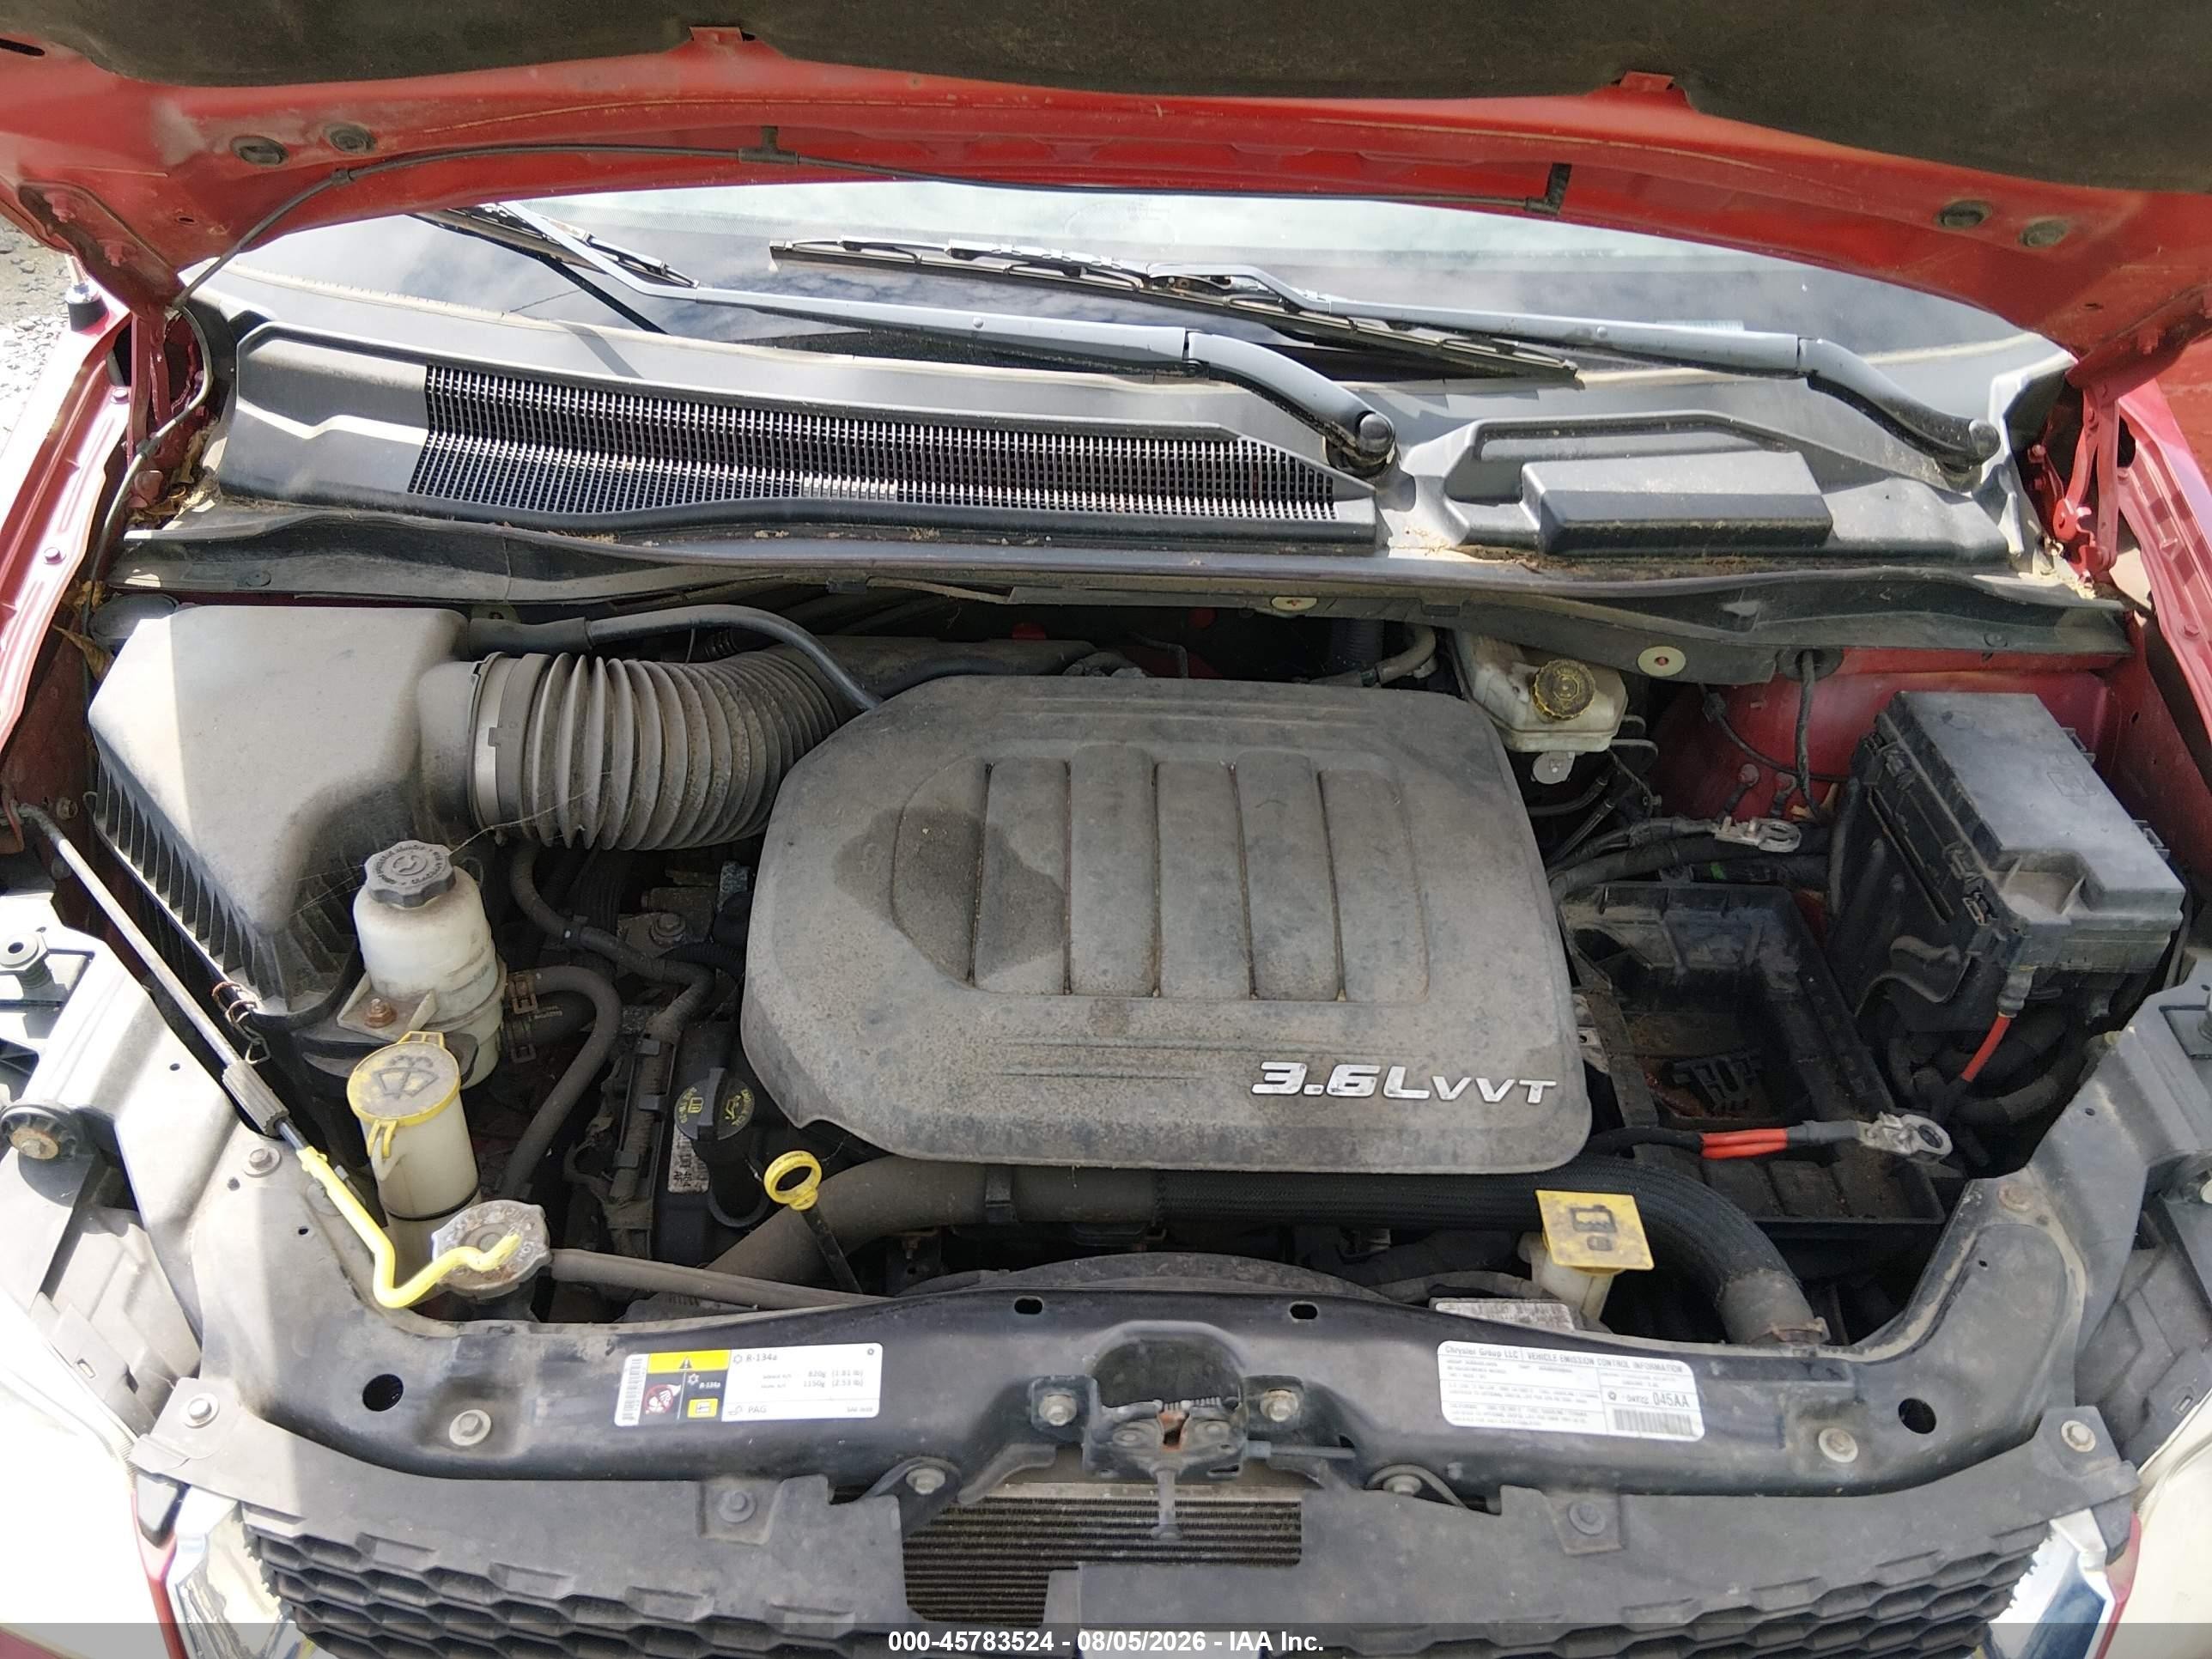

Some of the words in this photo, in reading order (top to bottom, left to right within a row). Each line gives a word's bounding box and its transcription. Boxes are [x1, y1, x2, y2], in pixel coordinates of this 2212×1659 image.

[746, 1352, 777, 1362] R-134a
[1444, 1346, 1476, 1356] Chrysler
[1479, 1348, 1502, 1358] Group
[1504, 1350, 1518, 1358] LLC
[1527, 1352, 1557, 1362] VEHICLE
[1559, 1355, 1595, 1366] EMISSION
[1597, 1358, 1630, 1369] CONTROL
[1632, 1361, 1683, 1373] INFORMATION
[1652, 1392, 1690, 1407] 045AA
[748, 1406, 767, 1414] PAG
